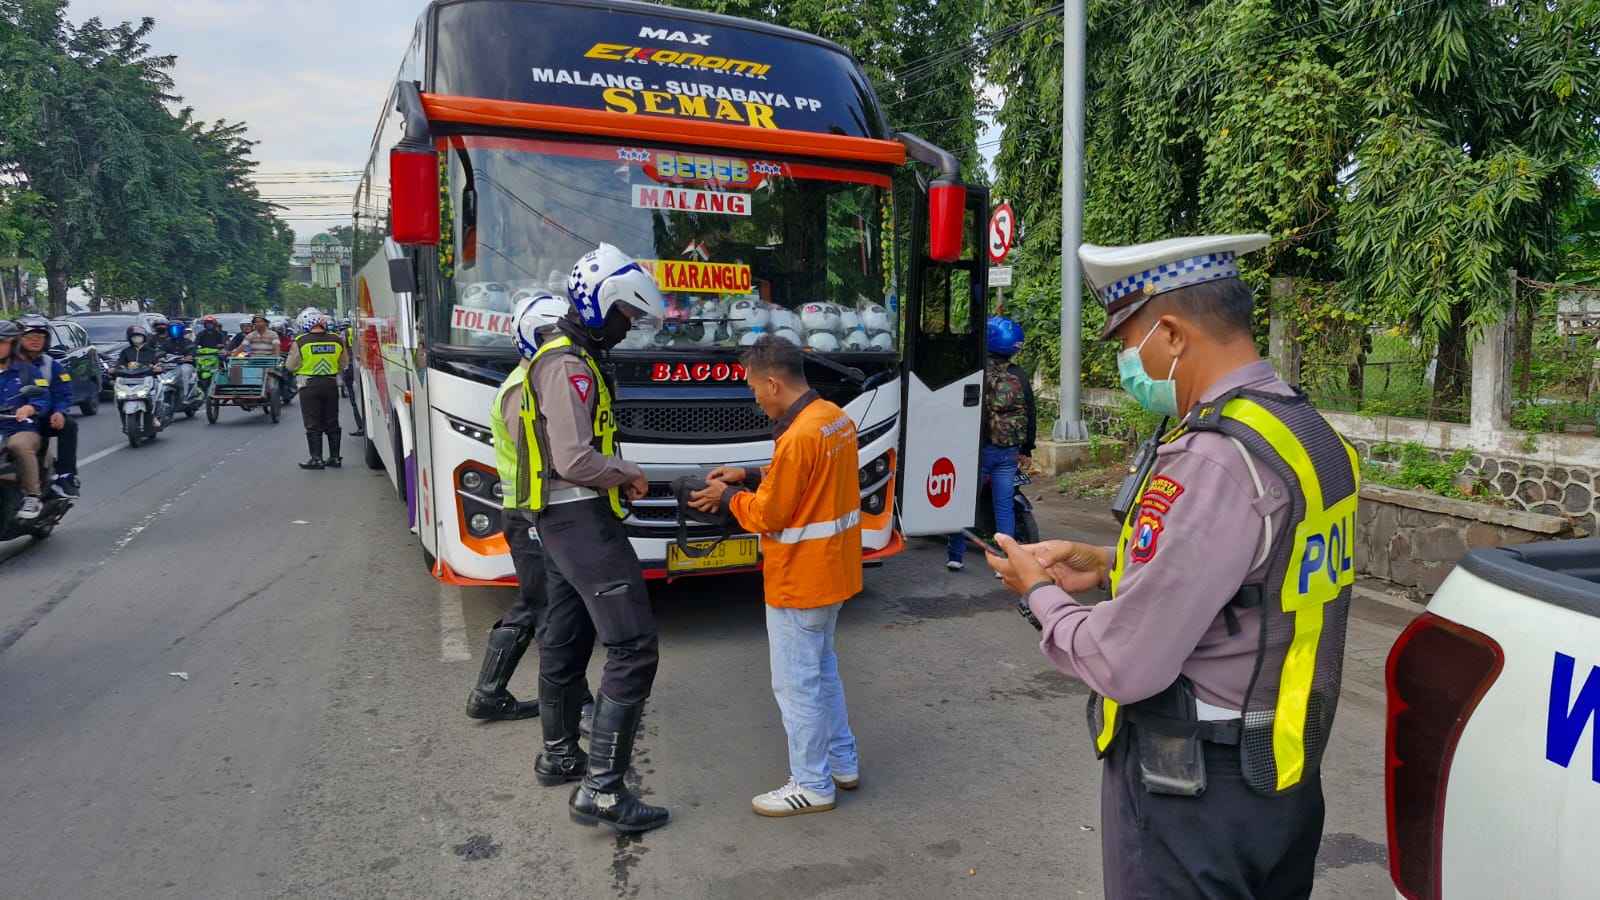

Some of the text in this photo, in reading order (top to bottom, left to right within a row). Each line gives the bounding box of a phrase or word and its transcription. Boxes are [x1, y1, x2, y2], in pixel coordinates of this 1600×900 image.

[638, 26, 713, 46] MAX
[532, 67, 645, 90] MALANG
[666, 80, 790, 108] SURABAYA
[794, 96, 822, 112] PP
[602, 87, 780, 130] SEMAR
[656, 153, 750, 184] BEBEB
[640, 188, 745, 214] MALANG
[664, 263, 751, 291] KARANGLO
[455, 309, 485, 332] TOL
[671, 546, 679, 561] N
[739, 540, 753, 556] UI
